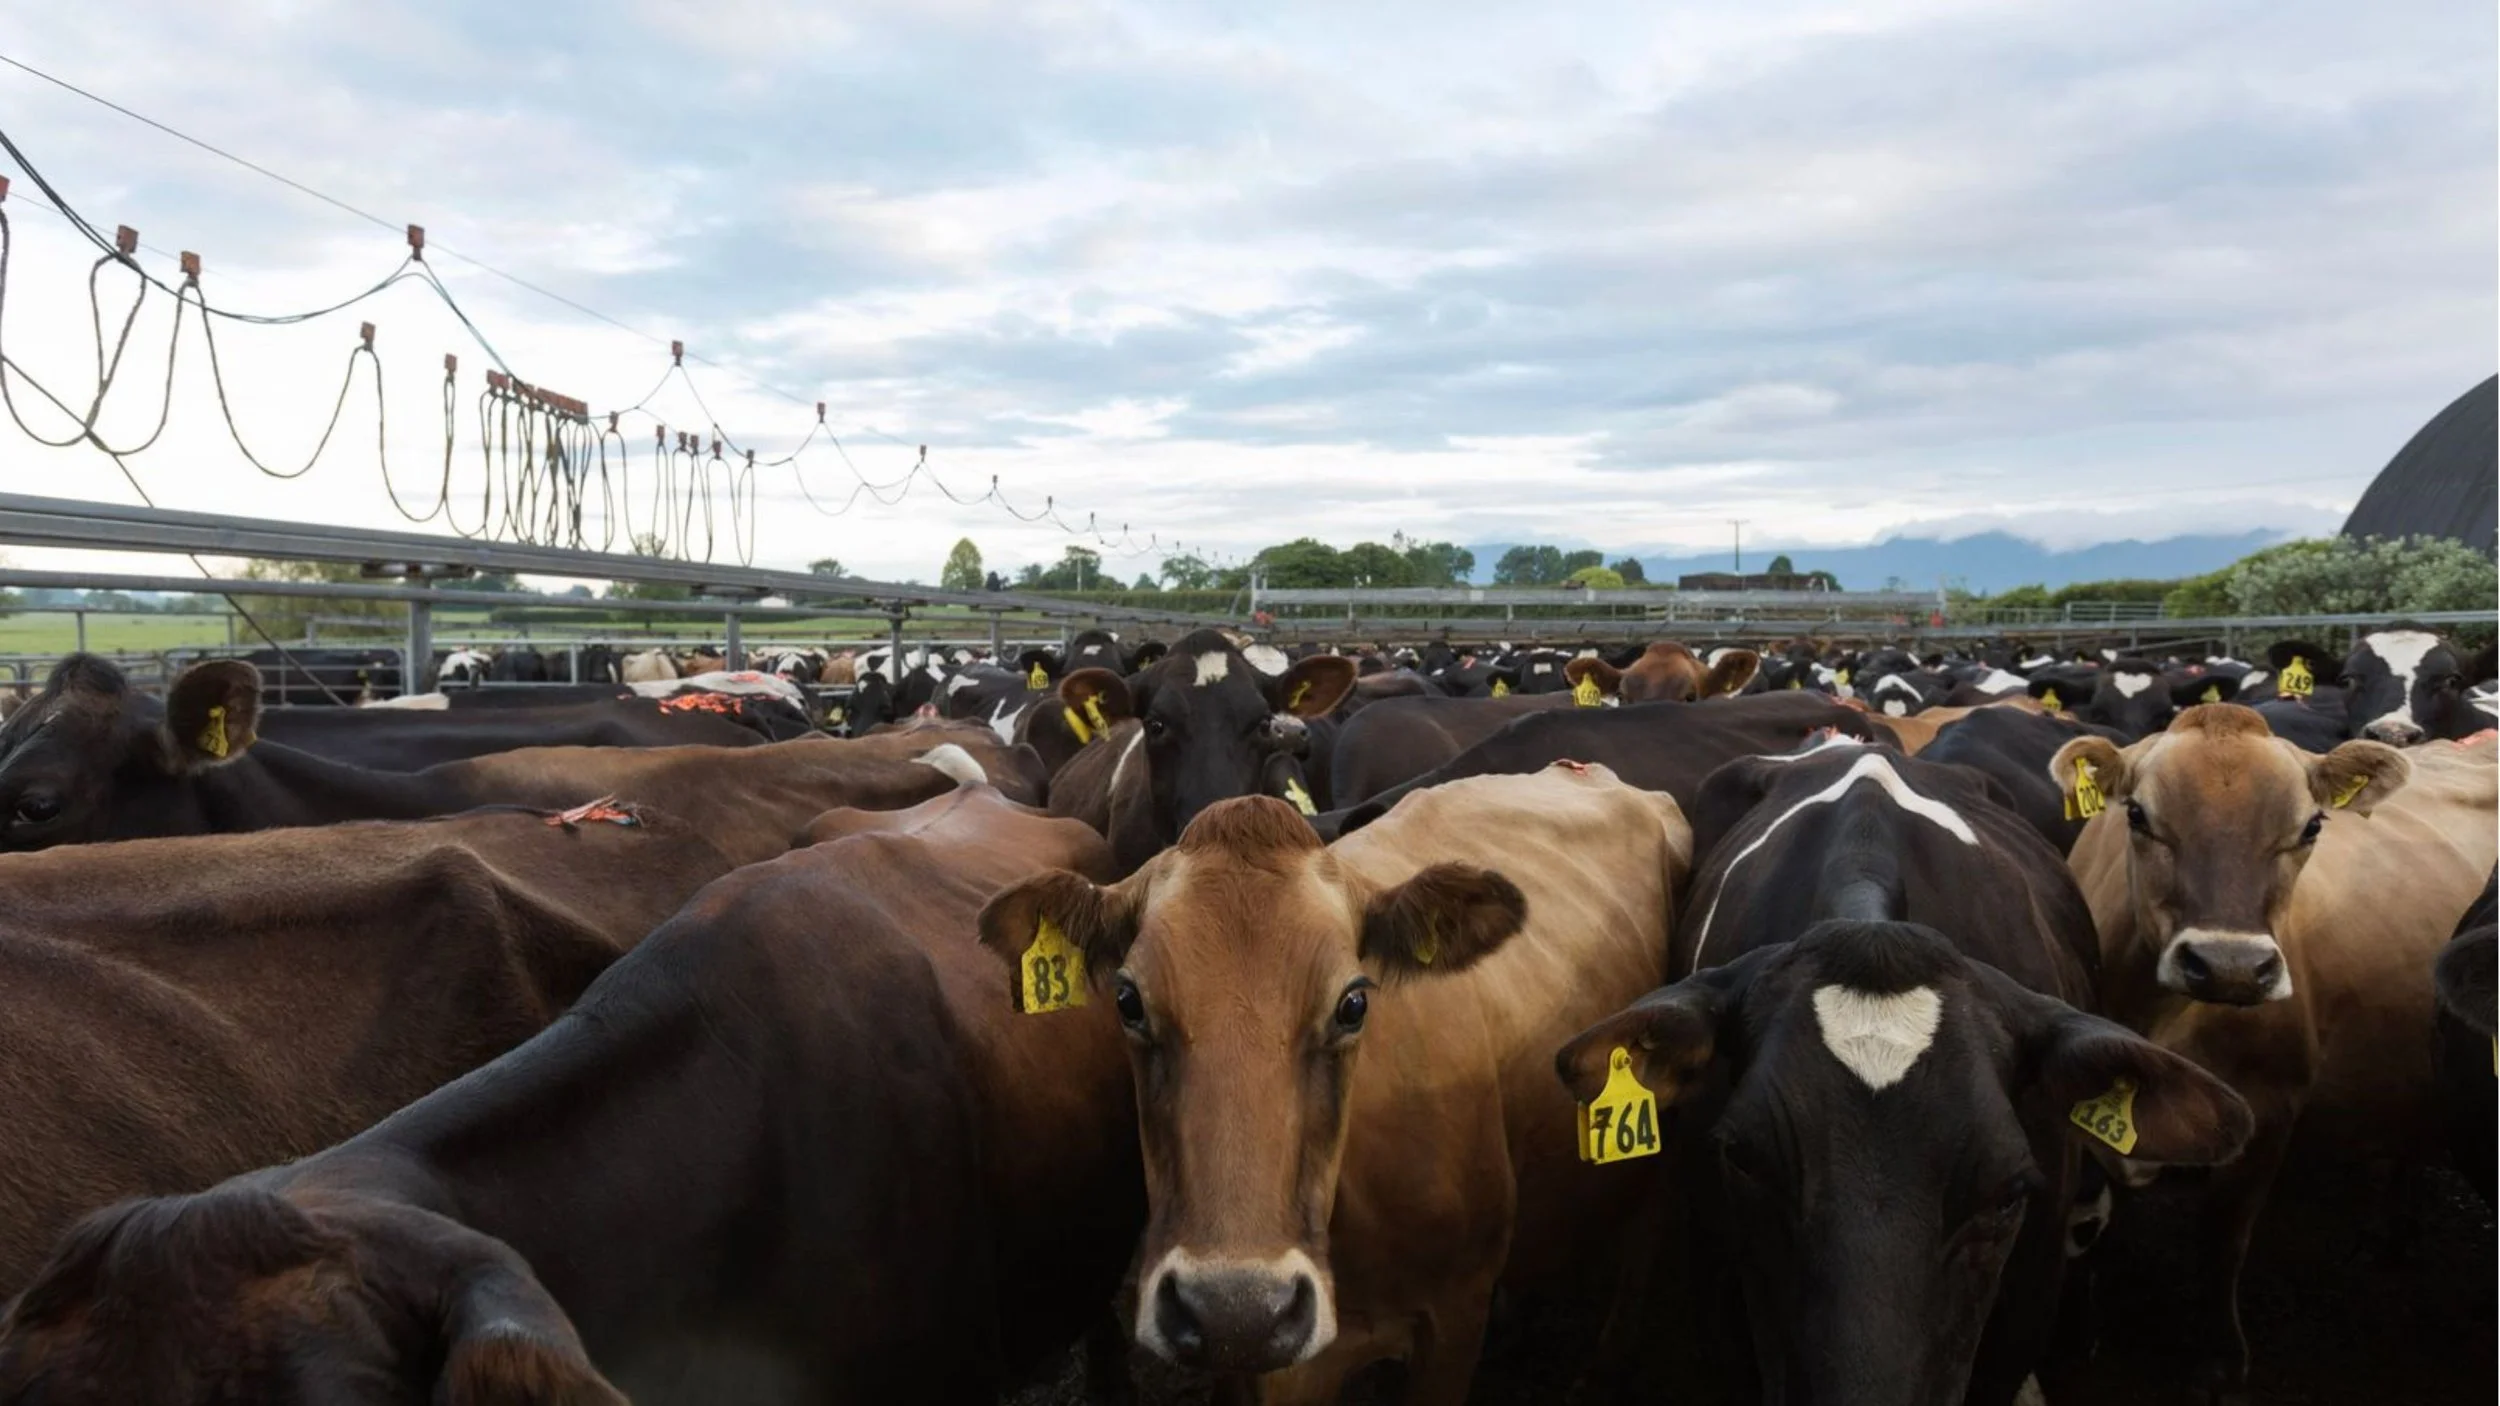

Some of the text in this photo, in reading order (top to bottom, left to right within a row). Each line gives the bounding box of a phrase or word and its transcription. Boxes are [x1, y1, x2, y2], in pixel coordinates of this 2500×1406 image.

[2286, 672, 2311, 691] 249
[1033, 954, 1070, 1005] 83
[1590, 1099, 1656, 1161] 764
[2078, 1102, 2128, 1143] 163
